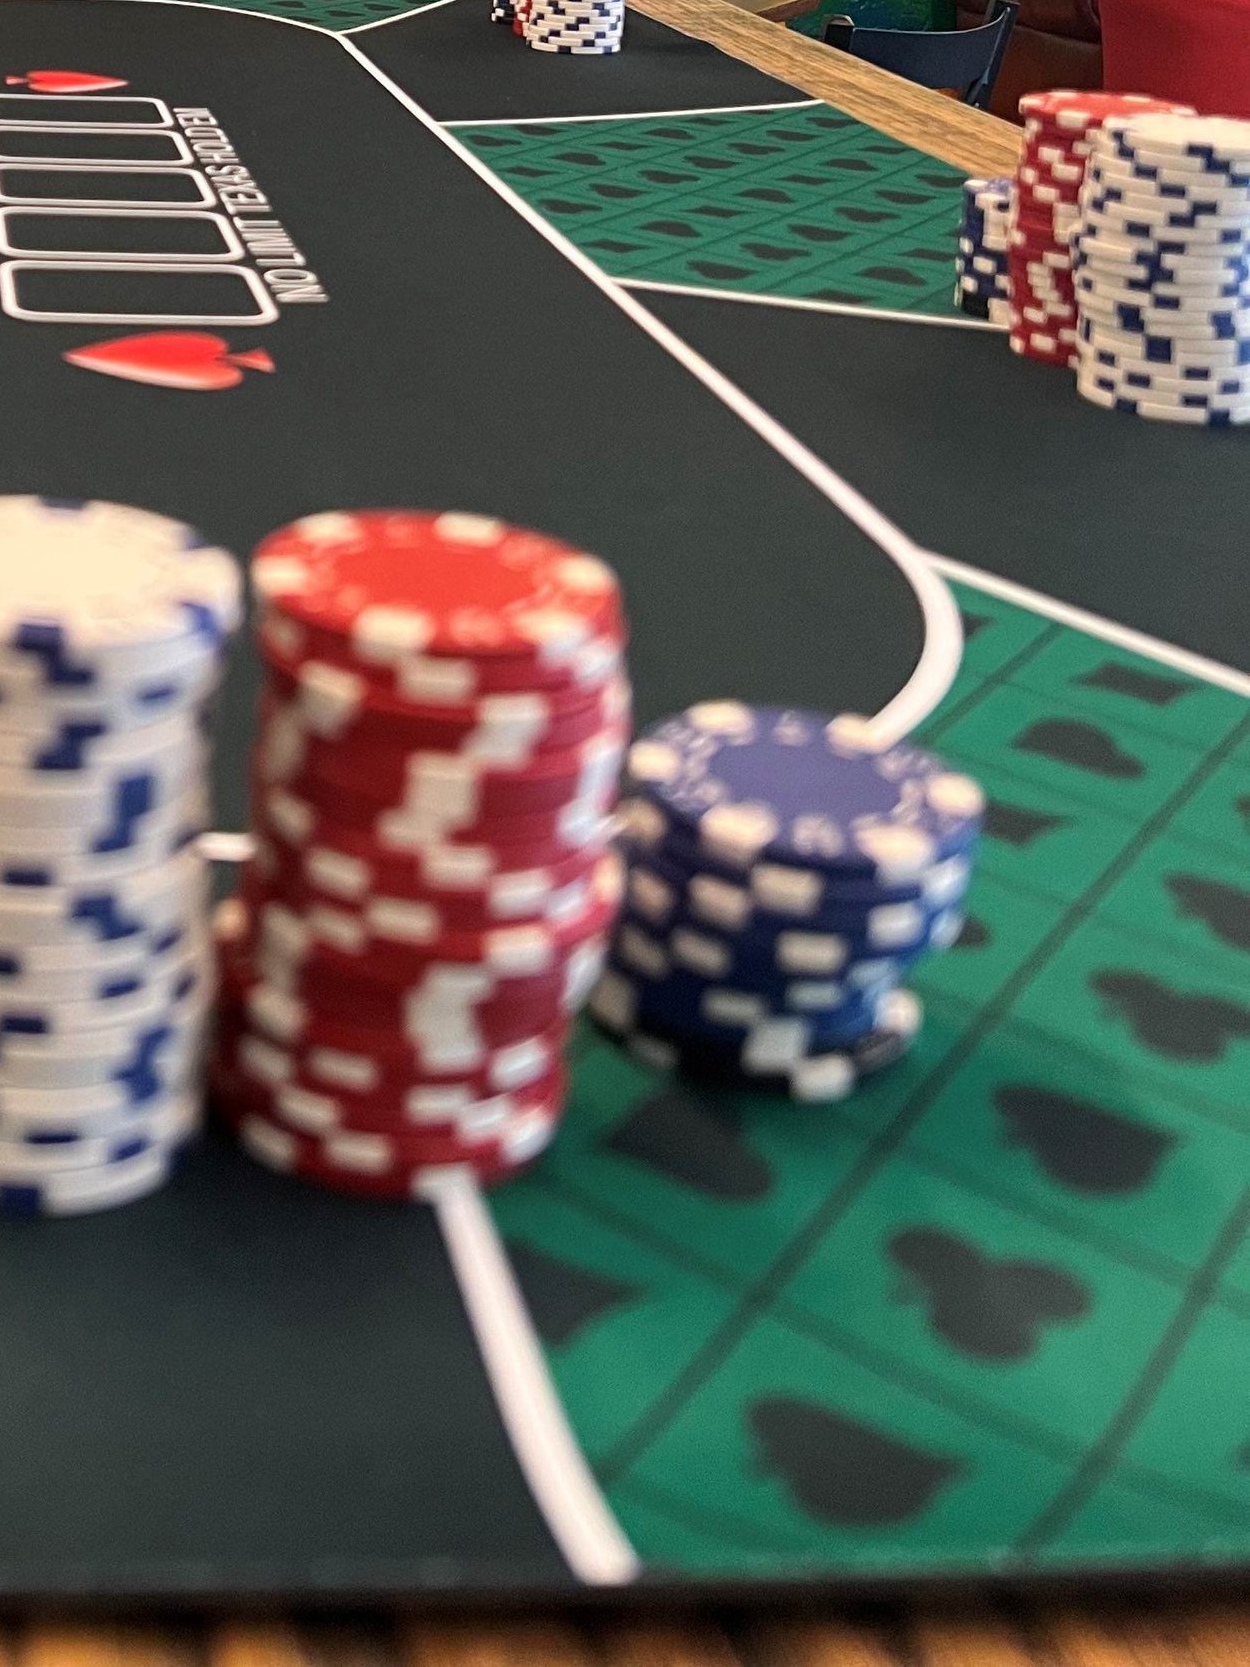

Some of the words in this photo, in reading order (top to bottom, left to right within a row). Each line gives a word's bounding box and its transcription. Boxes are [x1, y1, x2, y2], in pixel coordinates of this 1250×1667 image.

[205, 165, 272, 214] TEXAS
[233, 216, 306, 267] LIMIT
[264, 268, 329, 303] NO
